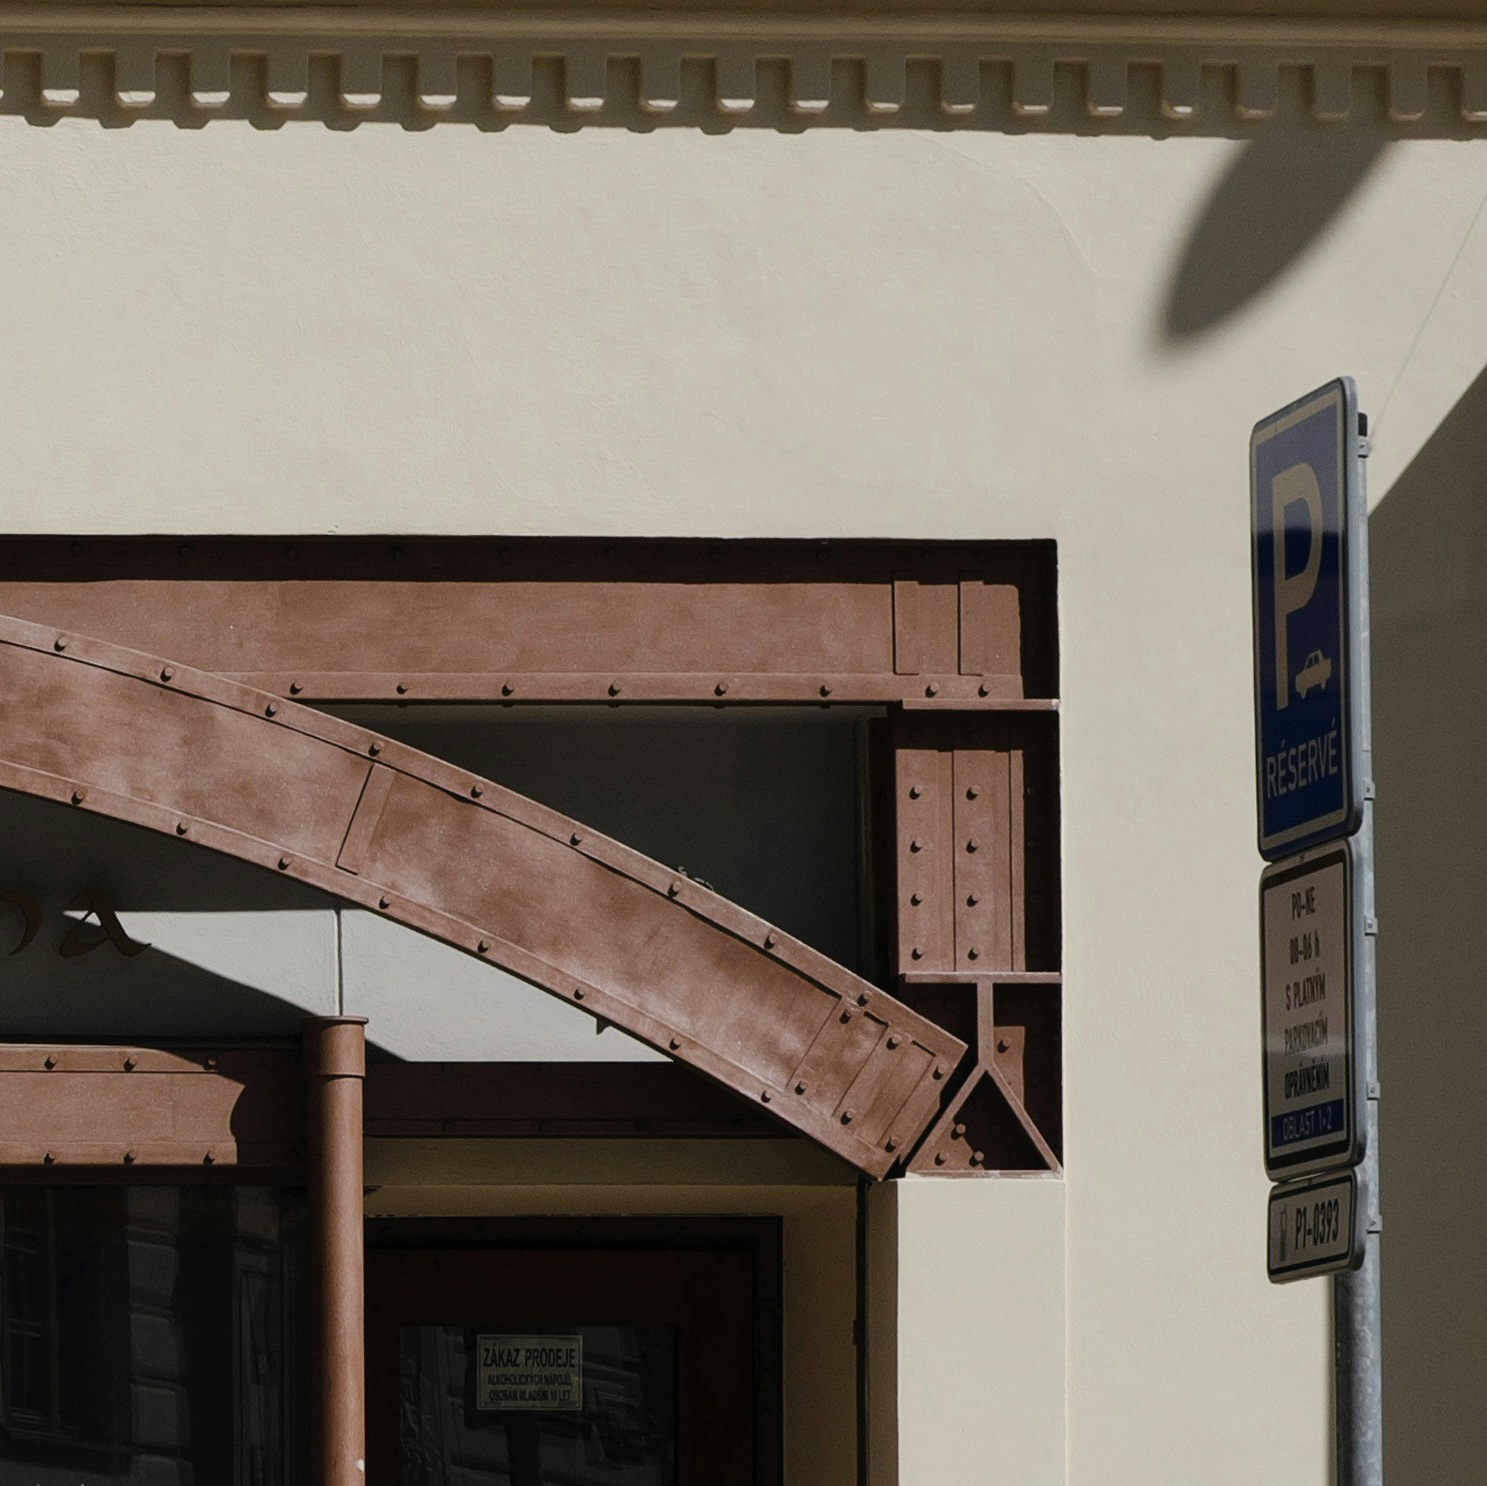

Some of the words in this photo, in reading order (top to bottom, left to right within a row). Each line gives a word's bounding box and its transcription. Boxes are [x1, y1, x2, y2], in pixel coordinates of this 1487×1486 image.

[1272, 462, 1324, 710] P
[1265, 721, 1338, 800] RÉSERVÉ
[1290, 886, 1316, 920] PO-NE
[1285, 983, 1292, 1011] S
[1293, 967, 1326, 1008] PLATNÝM
[1282, 1109, 1315, 1142] OBLAST
[1294, 1198, 1339, 1250] P1-0393
[483, 1344, 520, 1367] ZÁKAZ
[525, 1347, 576, 1368] PRODEJE
